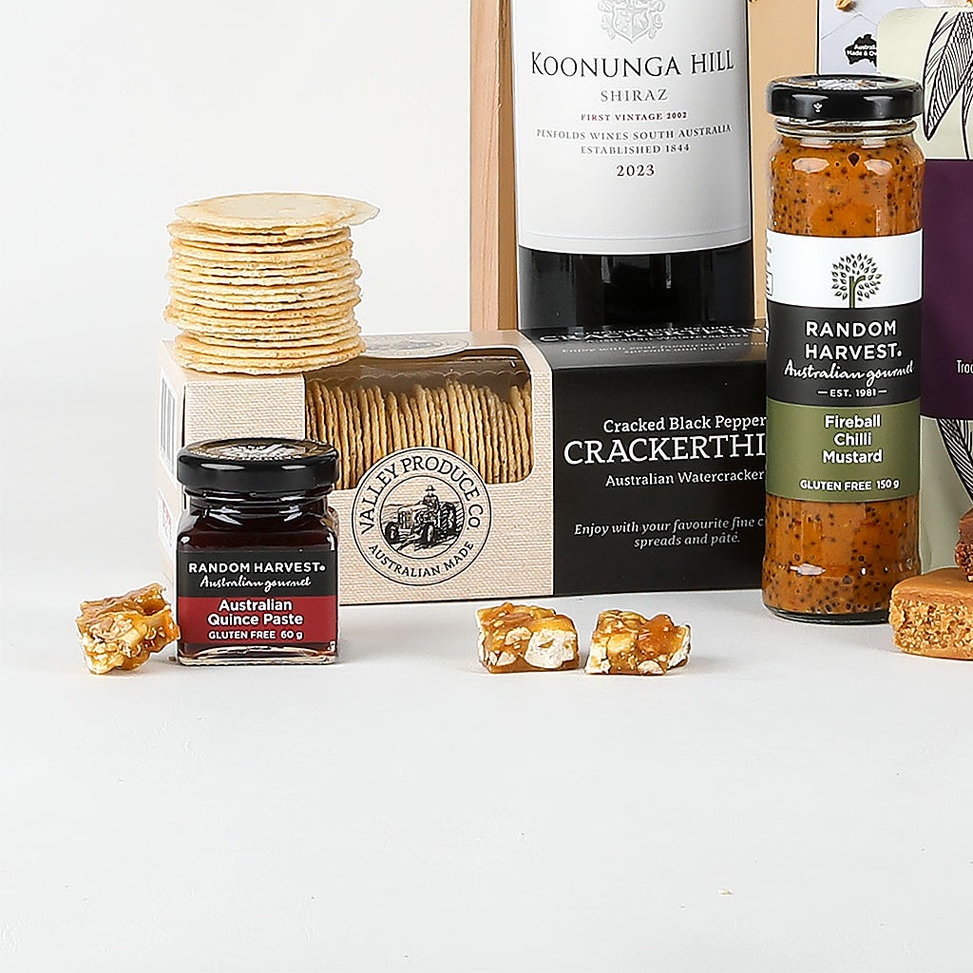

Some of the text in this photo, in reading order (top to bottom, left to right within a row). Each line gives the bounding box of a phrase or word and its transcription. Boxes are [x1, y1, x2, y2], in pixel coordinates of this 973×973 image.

[531, 49, 735, 78] KOONUNGA HILL
[600, 88, 669, 103] SHIRAZ
[580, 111, 688, 122] FIRST VINTAGE 2002
[536, 124, 733, 141] PENFOLDS WINES SOUTH AUSTRALIA
[580, 143, 690, 155] ESTABLISHED 1844
[615, 164, 656, 178] 2023
[805, 319, 898, 338] RANDOM
[783, 358, 915, 387] Australian gourmet
[830, 388, 878, 398] EST. 1981
[603, 414, 767, 434] Cracked Black Pepper
[824, 414, 882, 429] Fireball
[833, 432, 873, 447] Chilli
[563, 433, 767, 466] CRACKERTHI
[822, 449, 884, 465] Mustard
[604, 471, 675, 487] Australian
[800, 479, 842, 491] GLUTEN
[844, 480, 872, 491] FREE
[360, 456, 483, 534] VALLEY PRODUCE CO.
[574, 523, 610, 538] Enjoy
[611, 521, 639, 534] with
[641, 522, 671, 537] your
[671, 517, 729, 534] favourite
[730, 516, 756, 531] fine
[633, 531, 741, 550] spreads and pâté.
[369, 541, 473, 577] AUSTRALIAN MADE
[188, 561, 250, 574] RANDOM
[199, 575, 311, 593] Australian gourmet
[218, 597, 292, 612] Australian
[207, 612, 304, 627] Quince Paste
[208, 630, 248, 640] GLUTEN
[250, 630, 276, 640] FREE
